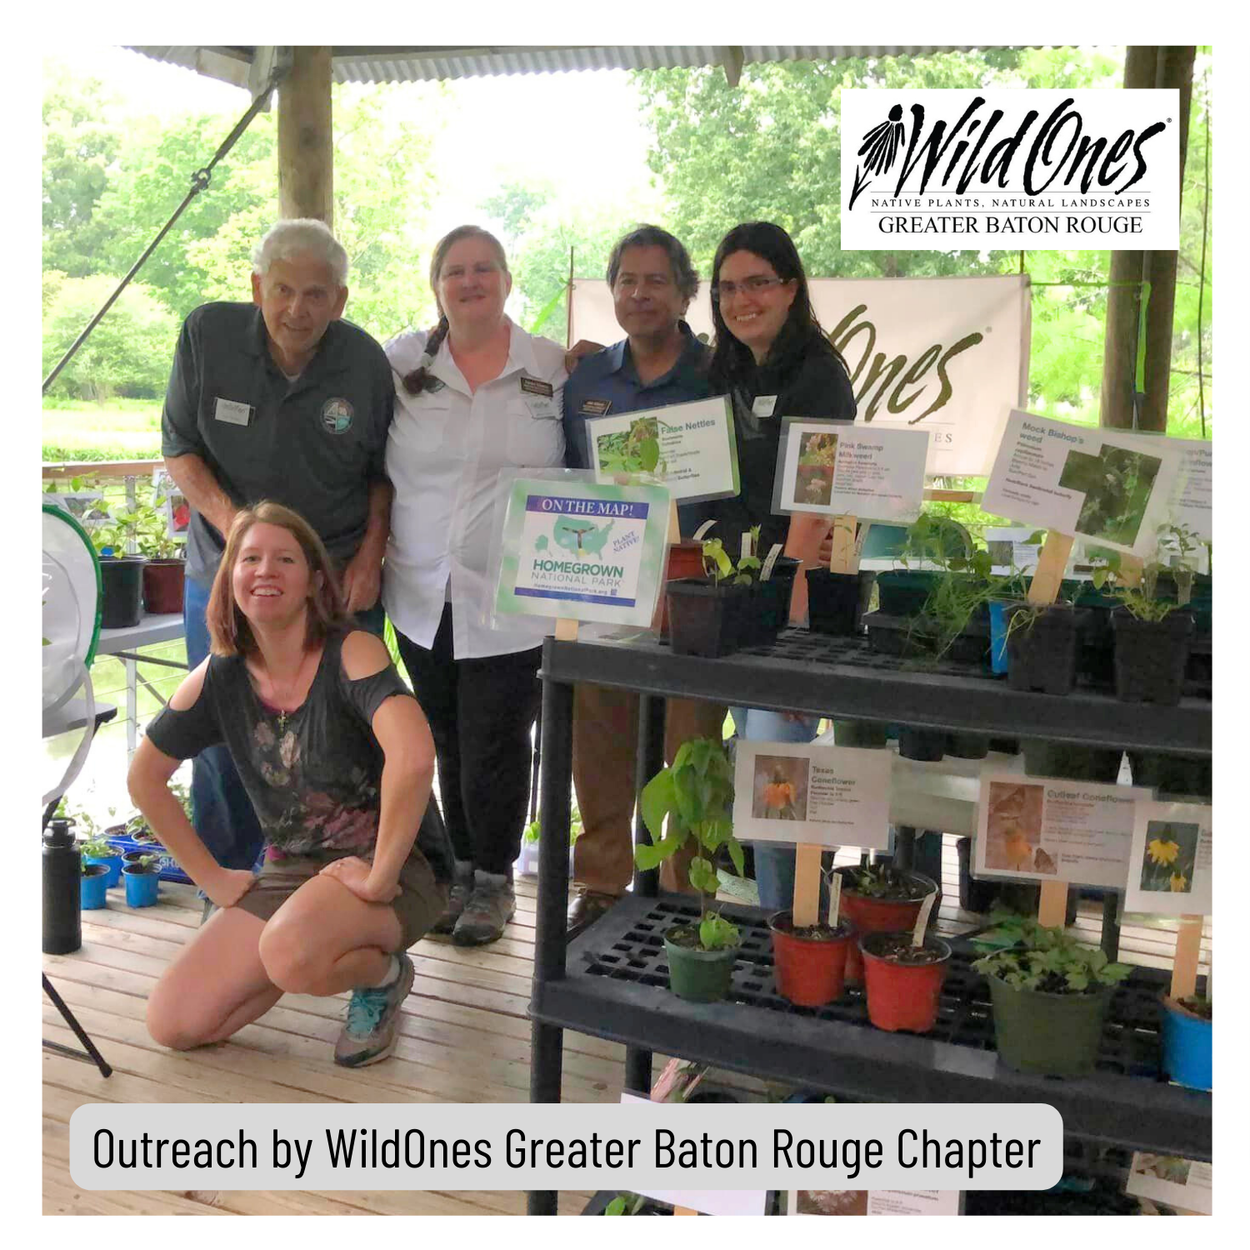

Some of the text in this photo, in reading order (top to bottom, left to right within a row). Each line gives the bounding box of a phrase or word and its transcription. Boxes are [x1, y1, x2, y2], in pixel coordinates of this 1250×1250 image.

[685, 419, 716, 430] Nettles
[1021, 421, 1046, 435] Mock
[1019, 432, 1043, 444] weed
[839, 442, 884, 453] Pink Swamp
[542, 499, 634, 516] ON THE MAP!
[612, 530, 636, 547] PLANT
[613, 535, 640, 554] NATIVE!
[533, 559, 624, 578] HOMEGROWN
[531, 571, 622, 588] NATIONAL PARK
[812, 765, 834, 775] Texas
[811, 776, 856, 786] Coneflower
[1047, 789, 1080, 799] Cutleaf
